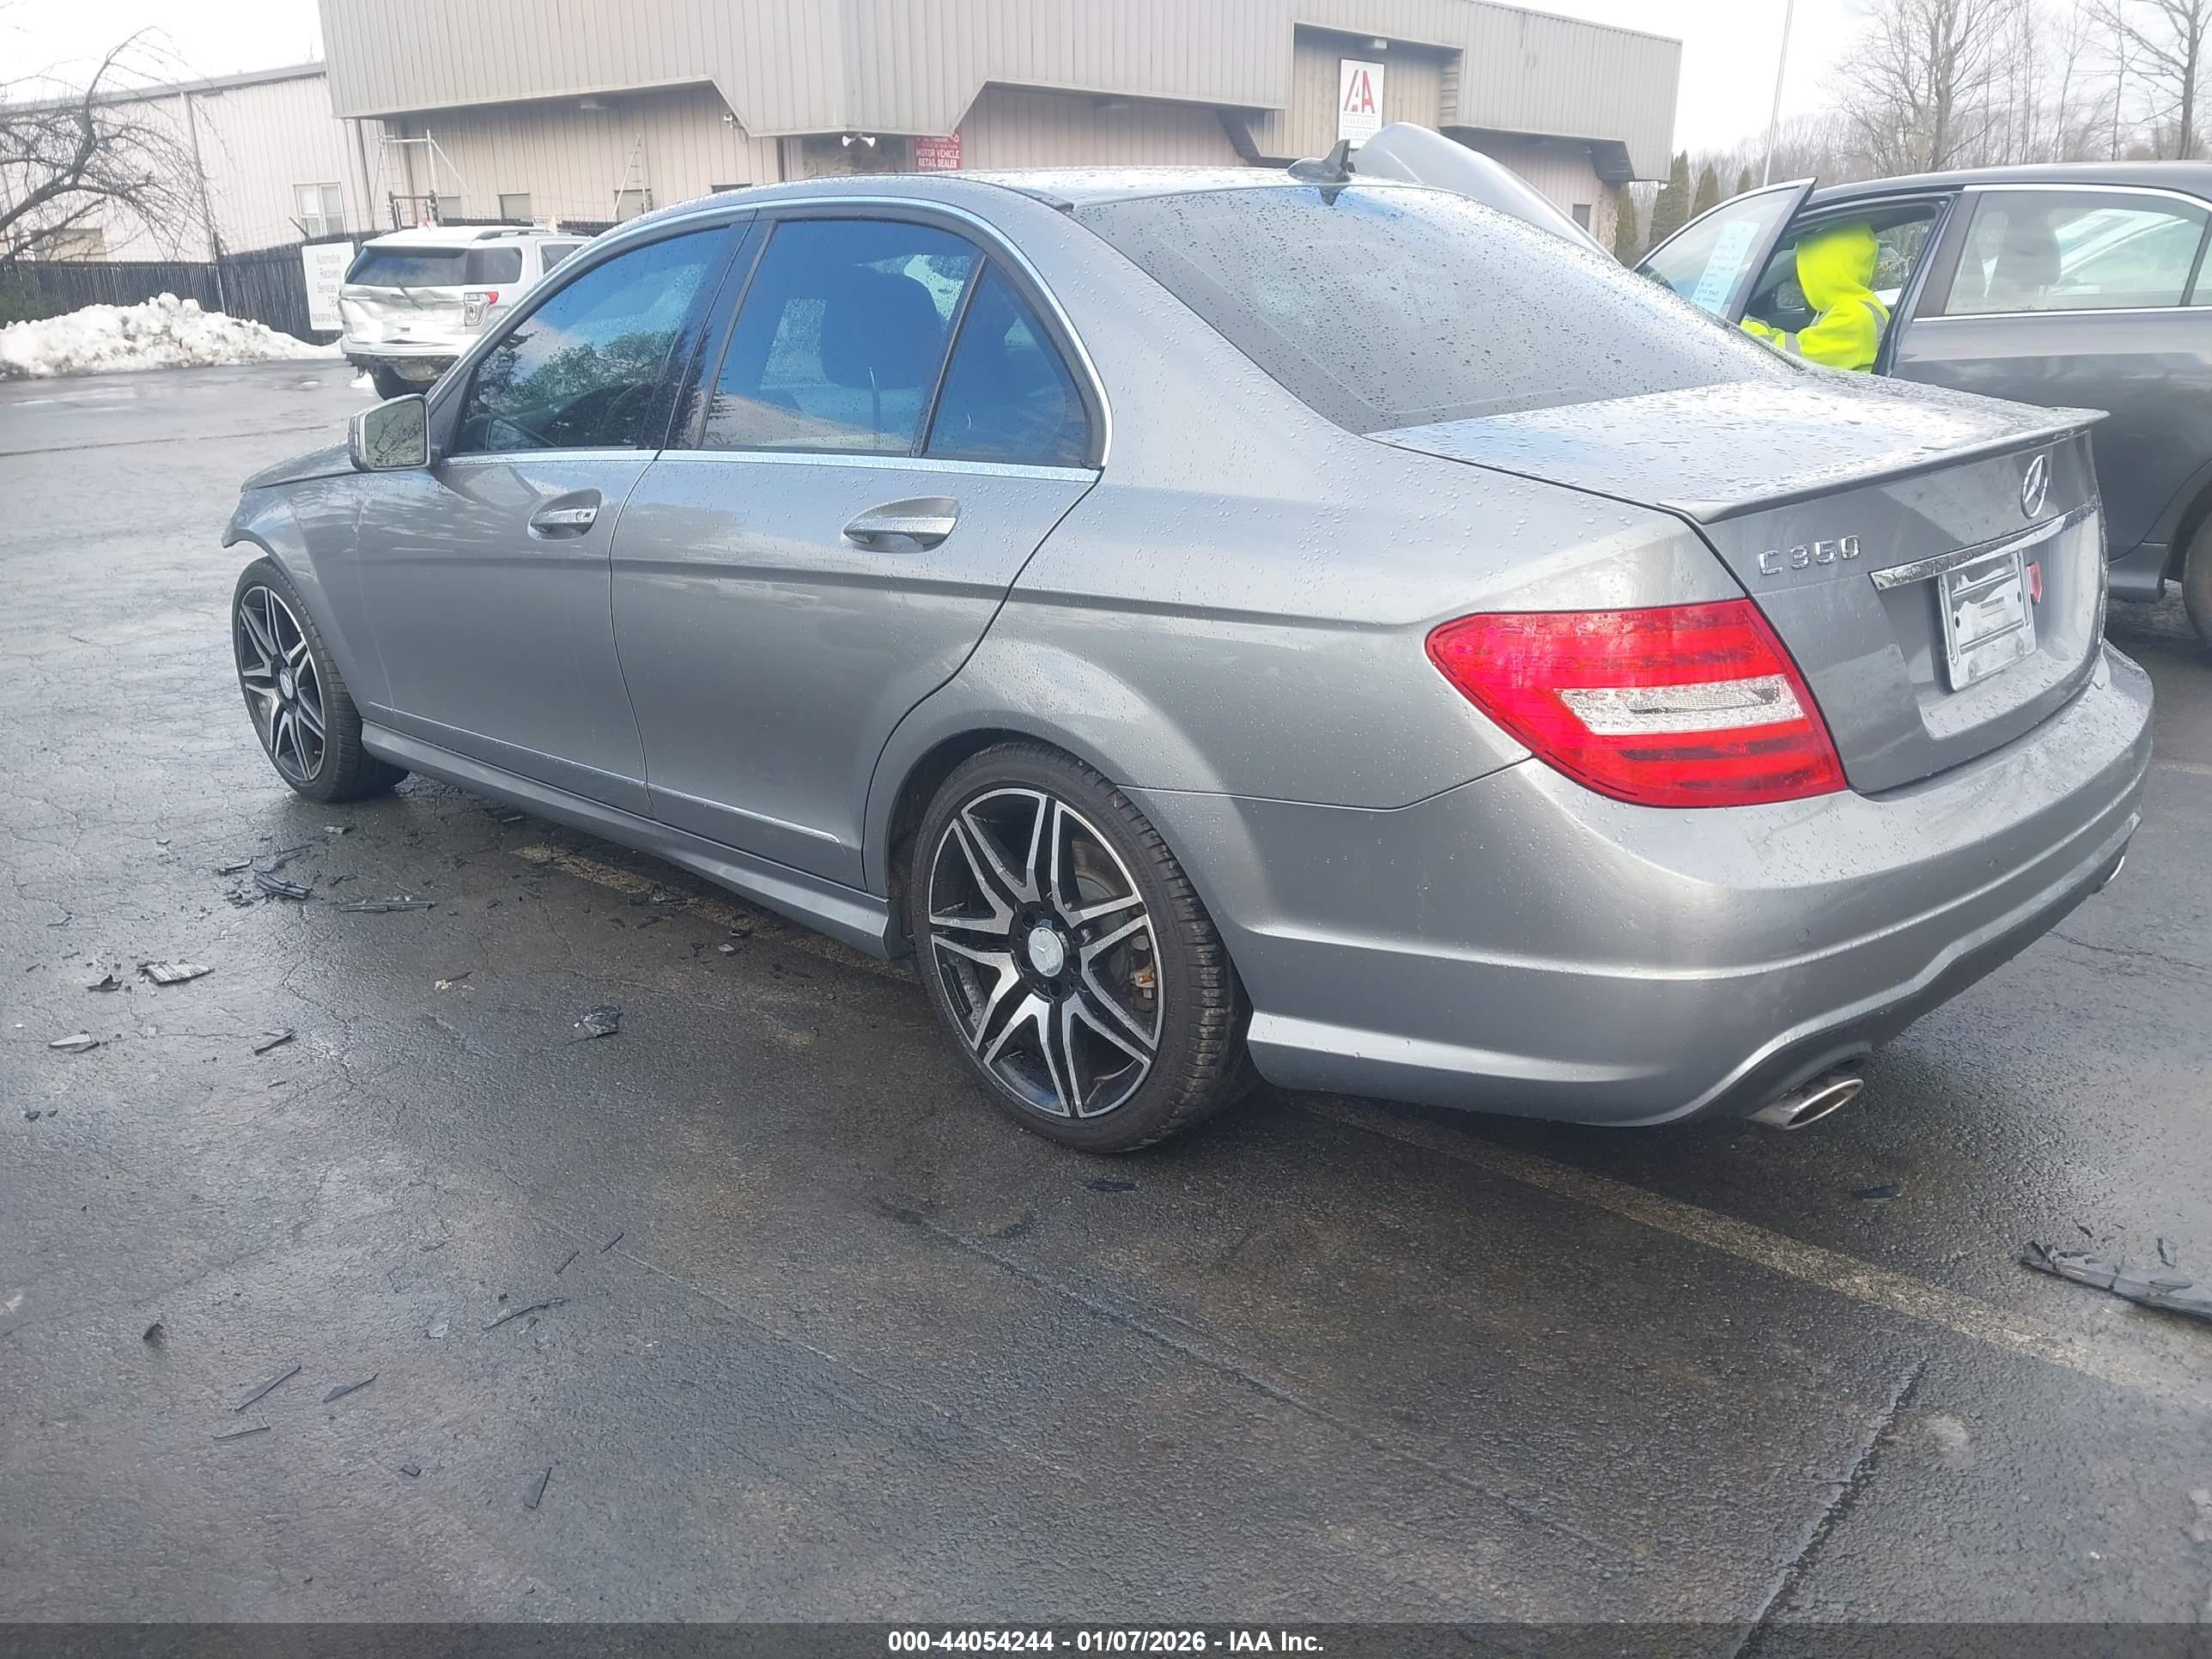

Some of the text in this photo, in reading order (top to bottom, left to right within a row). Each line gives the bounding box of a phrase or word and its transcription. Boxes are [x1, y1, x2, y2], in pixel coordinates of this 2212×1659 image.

[915, 148, 960, 159] MOTOR VEHICLE
[918, 157, 957, 168] RETAIL DEALER
